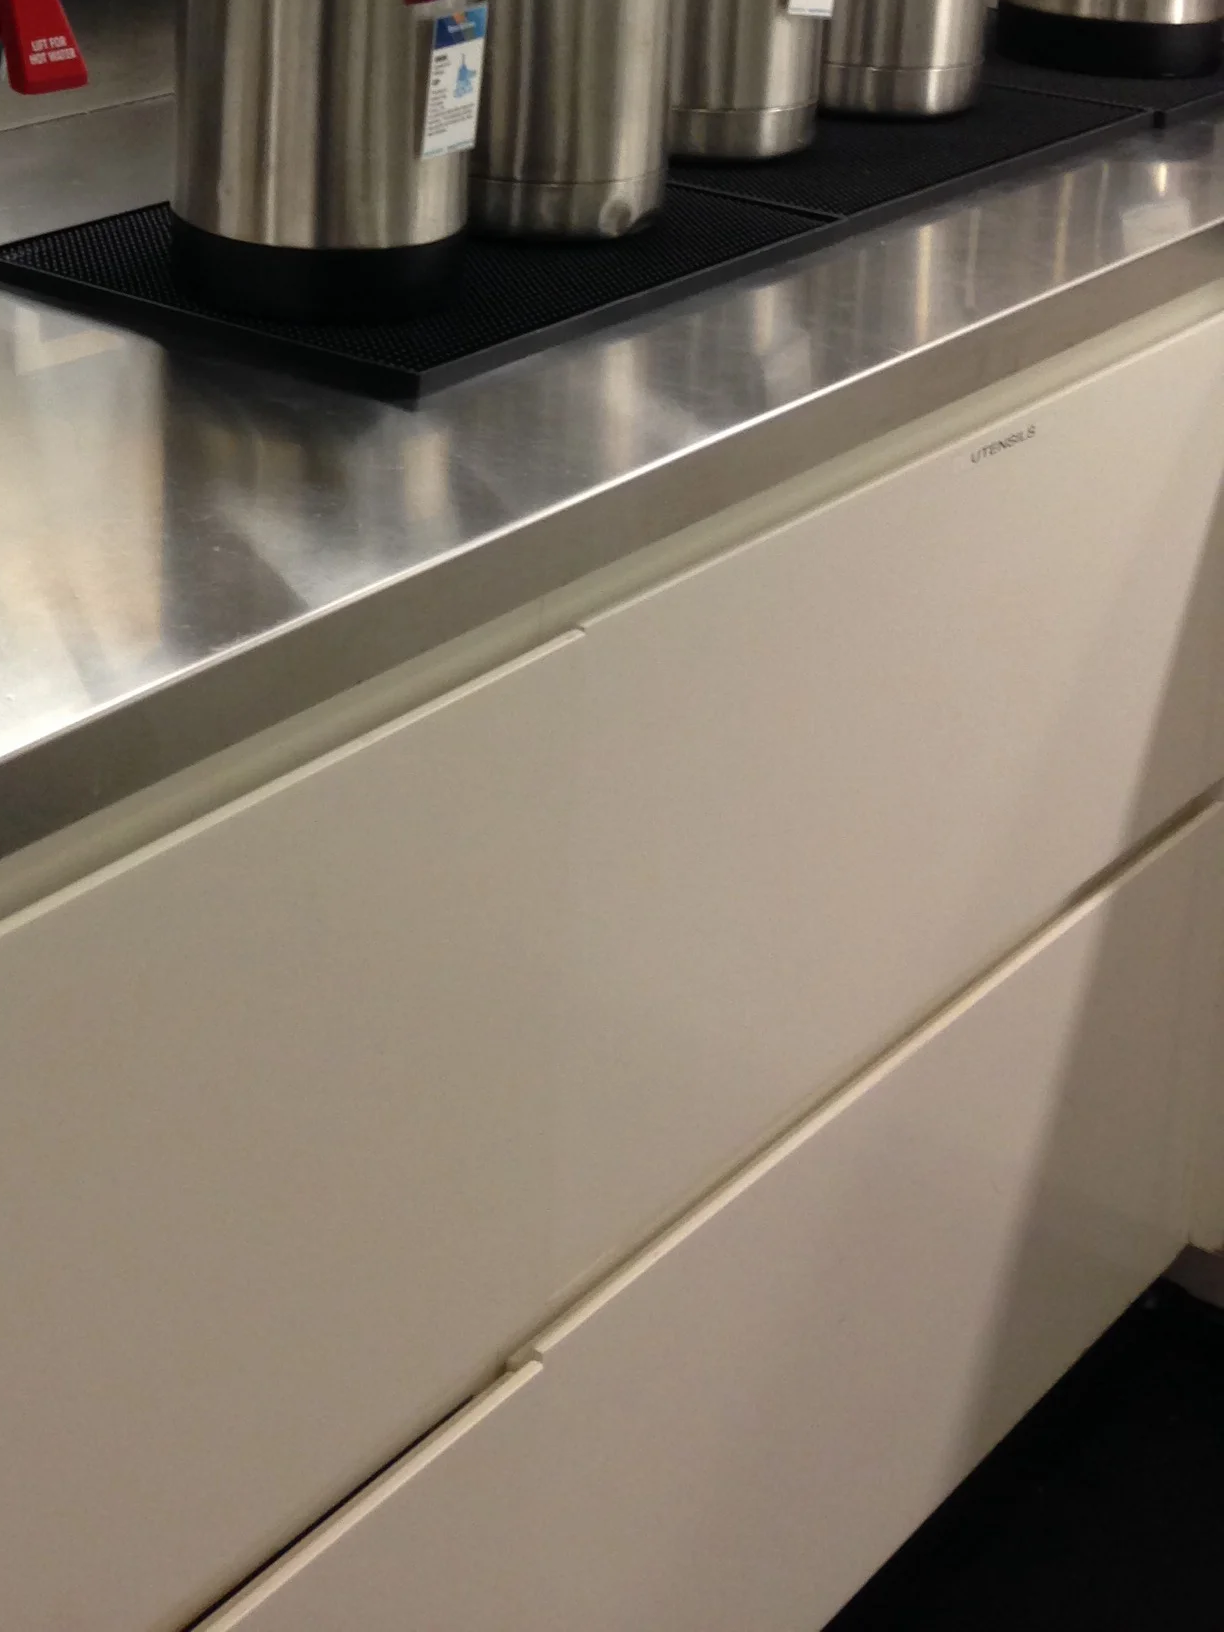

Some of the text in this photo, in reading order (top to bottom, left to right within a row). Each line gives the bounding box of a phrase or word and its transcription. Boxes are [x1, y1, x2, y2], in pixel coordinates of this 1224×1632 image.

[49, 35, 67, 48] FOR
[48, 47, 76, 62] WATER
[969, 424, 1037, 465] UTENSILS
